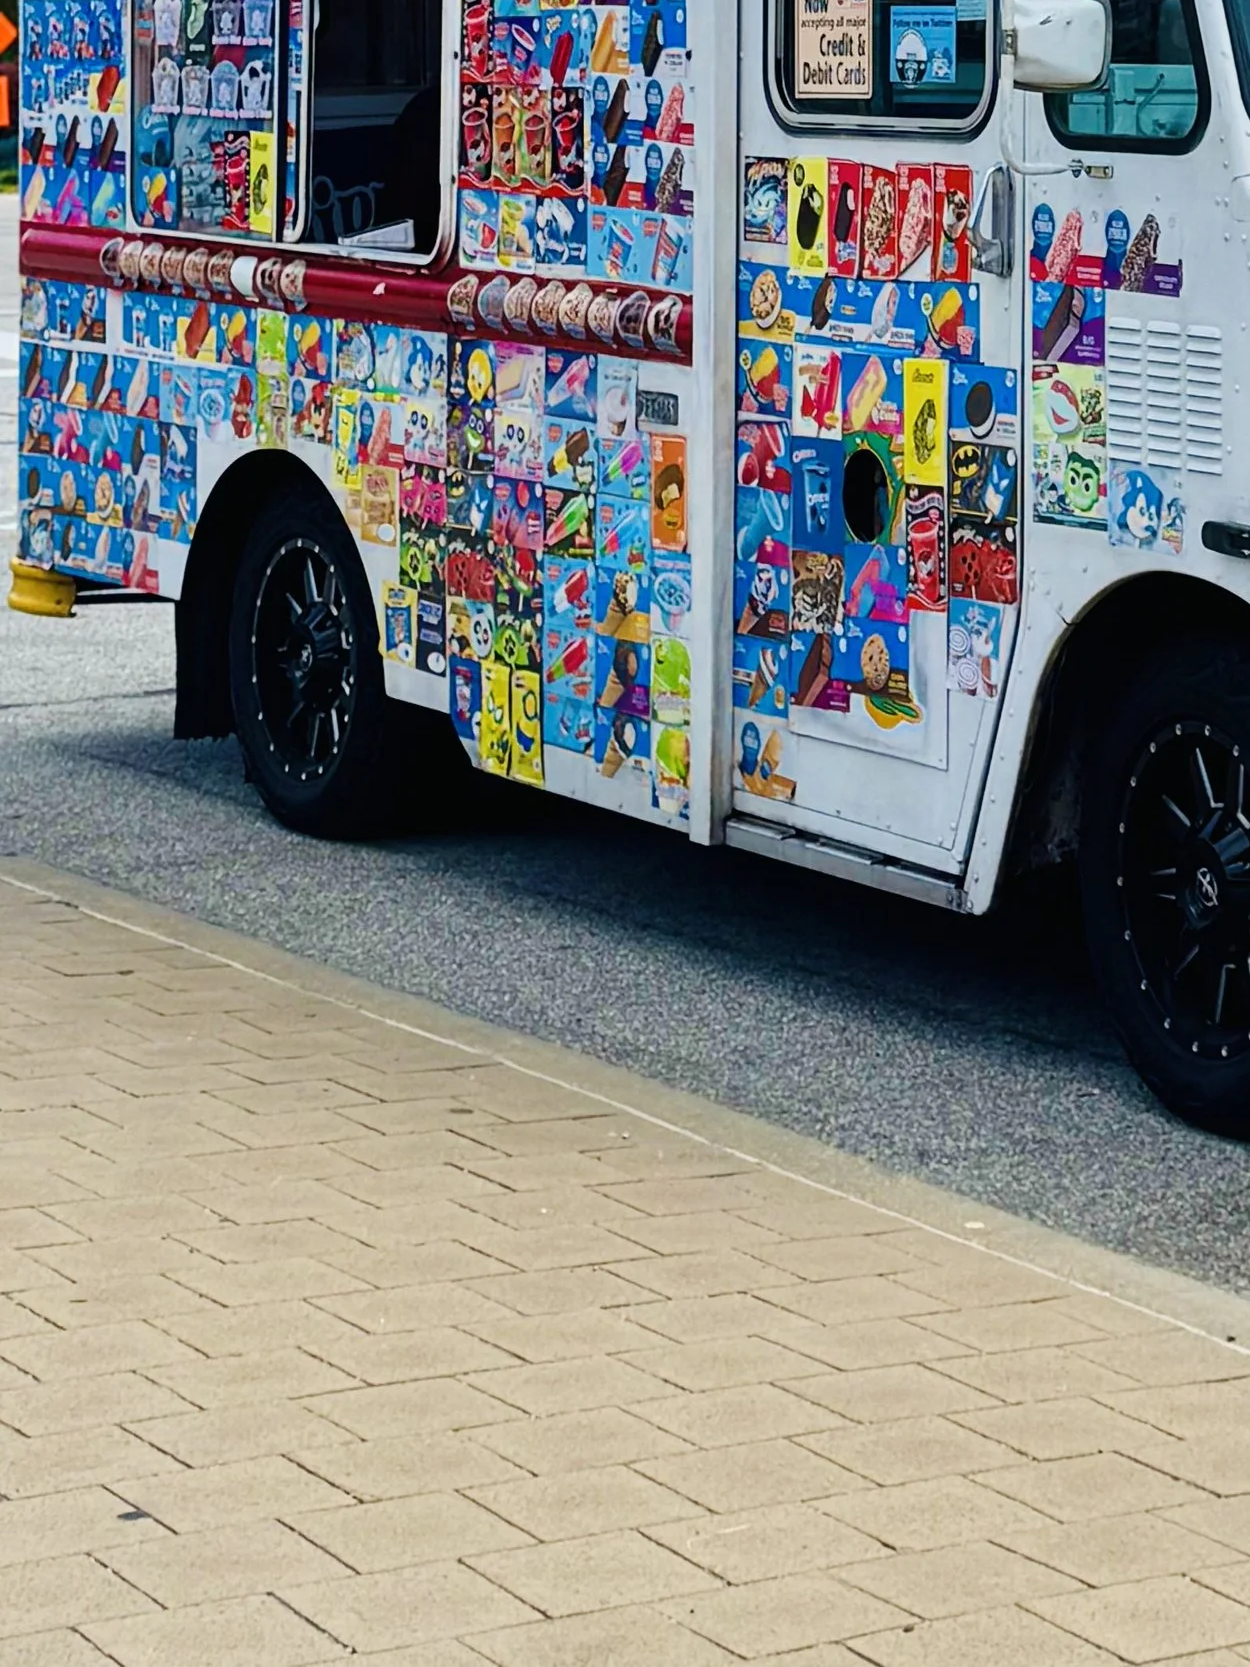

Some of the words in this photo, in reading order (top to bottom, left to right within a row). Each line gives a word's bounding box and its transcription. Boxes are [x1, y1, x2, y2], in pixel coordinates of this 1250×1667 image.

[800, 16, 835, 31] accepting
[836, 16, 844, 27] all
[846, 16, 866, 30] major
[820, 32, 853, 57] Credit
[857, 33, 866, 57] &
[803, 61, 833, 85] Debit
[836, 60, 866, 86] Cards
